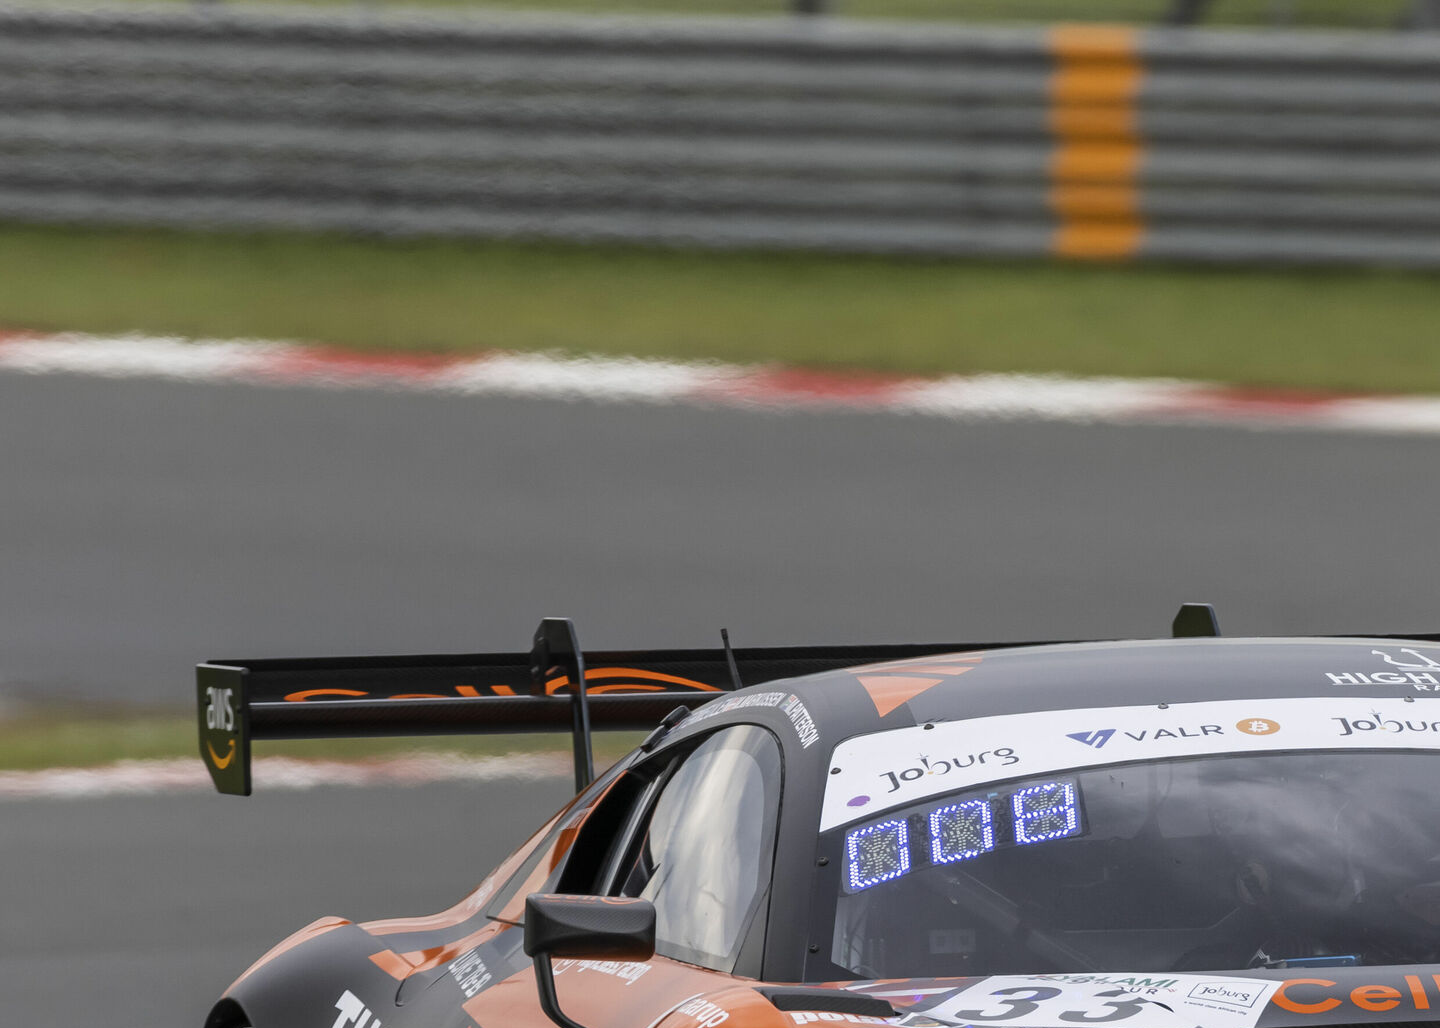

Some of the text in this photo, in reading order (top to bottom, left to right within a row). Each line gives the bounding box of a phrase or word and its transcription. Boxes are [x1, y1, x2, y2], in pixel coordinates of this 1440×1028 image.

[1325, 672, 1435, 684] HIGH
[206, 687, 233, 731] aws
[1124, 723, 1225, 743] VALR
[879, 745, 1020, 793] Joburg
[956, 986, 1144, 1022] 33
[1198, 985, 1252, 1001] Joburg
